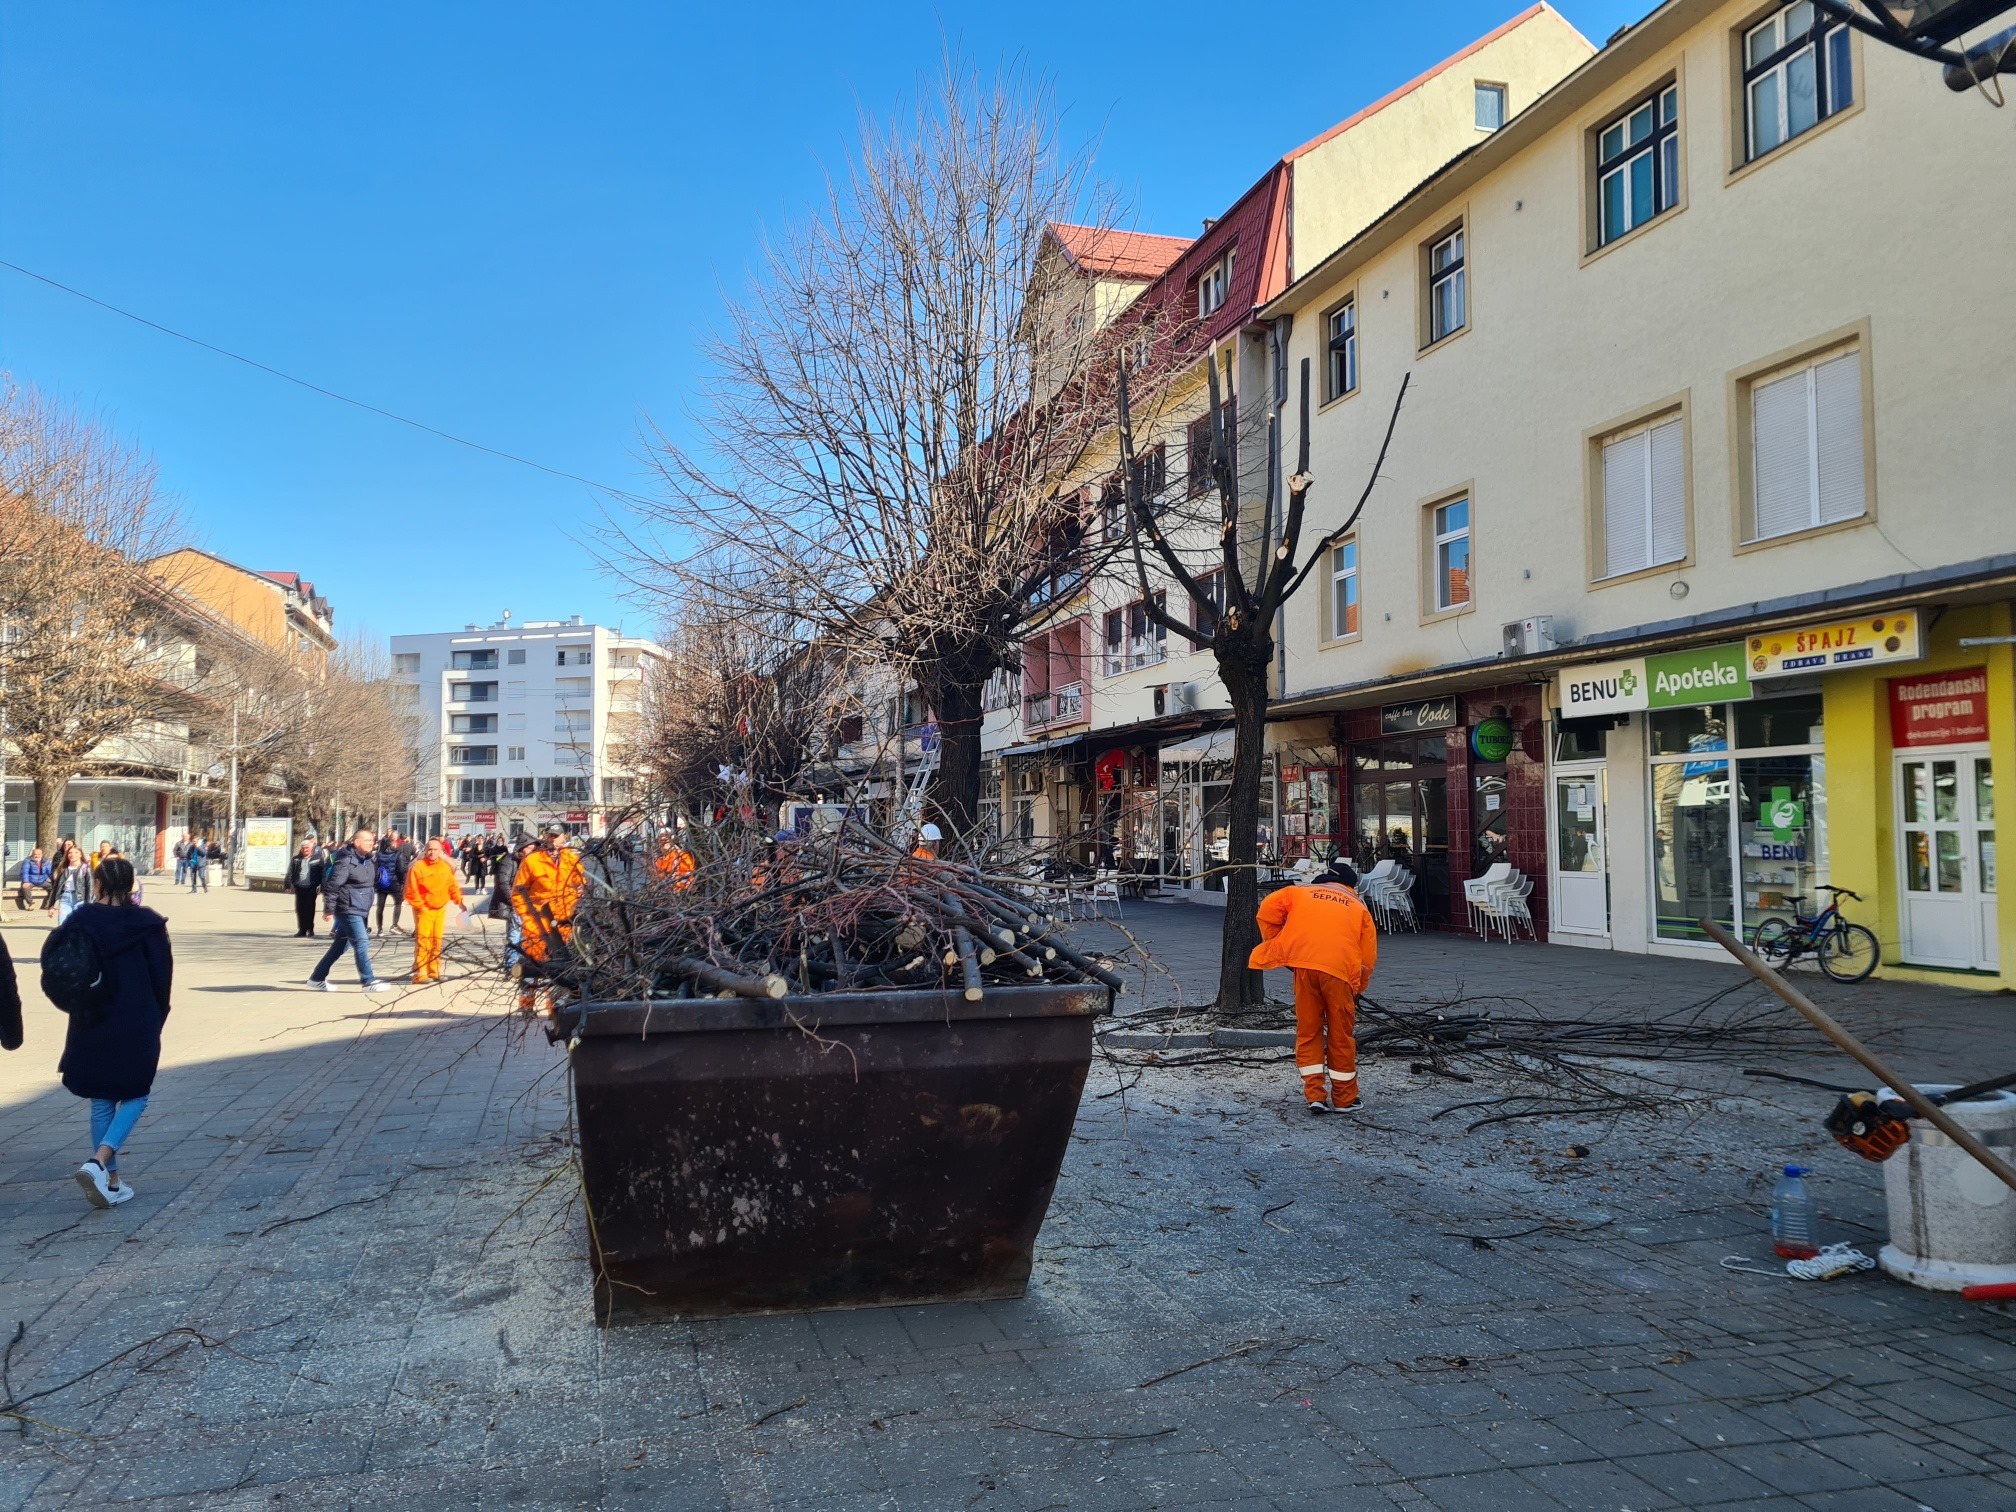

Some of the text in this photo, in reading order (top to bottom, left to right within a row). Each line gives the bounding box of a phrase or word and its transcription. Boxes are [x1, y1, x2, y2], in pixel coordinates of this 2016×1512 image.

[1796, 627, 1857, 653] ŠPAJZ
[1783, 650, 1873, 669] ZDRAVA HRANA
[1570, 661, 1738, 703] BENU Apoteka
[1385, 703, 1450, 726] caffe bar Code
[1912, 700, 1973, 721] program
[1762, 844, 1806, 861] BENU
[1313, 892, 1351, 907] БЕРАНЕ
